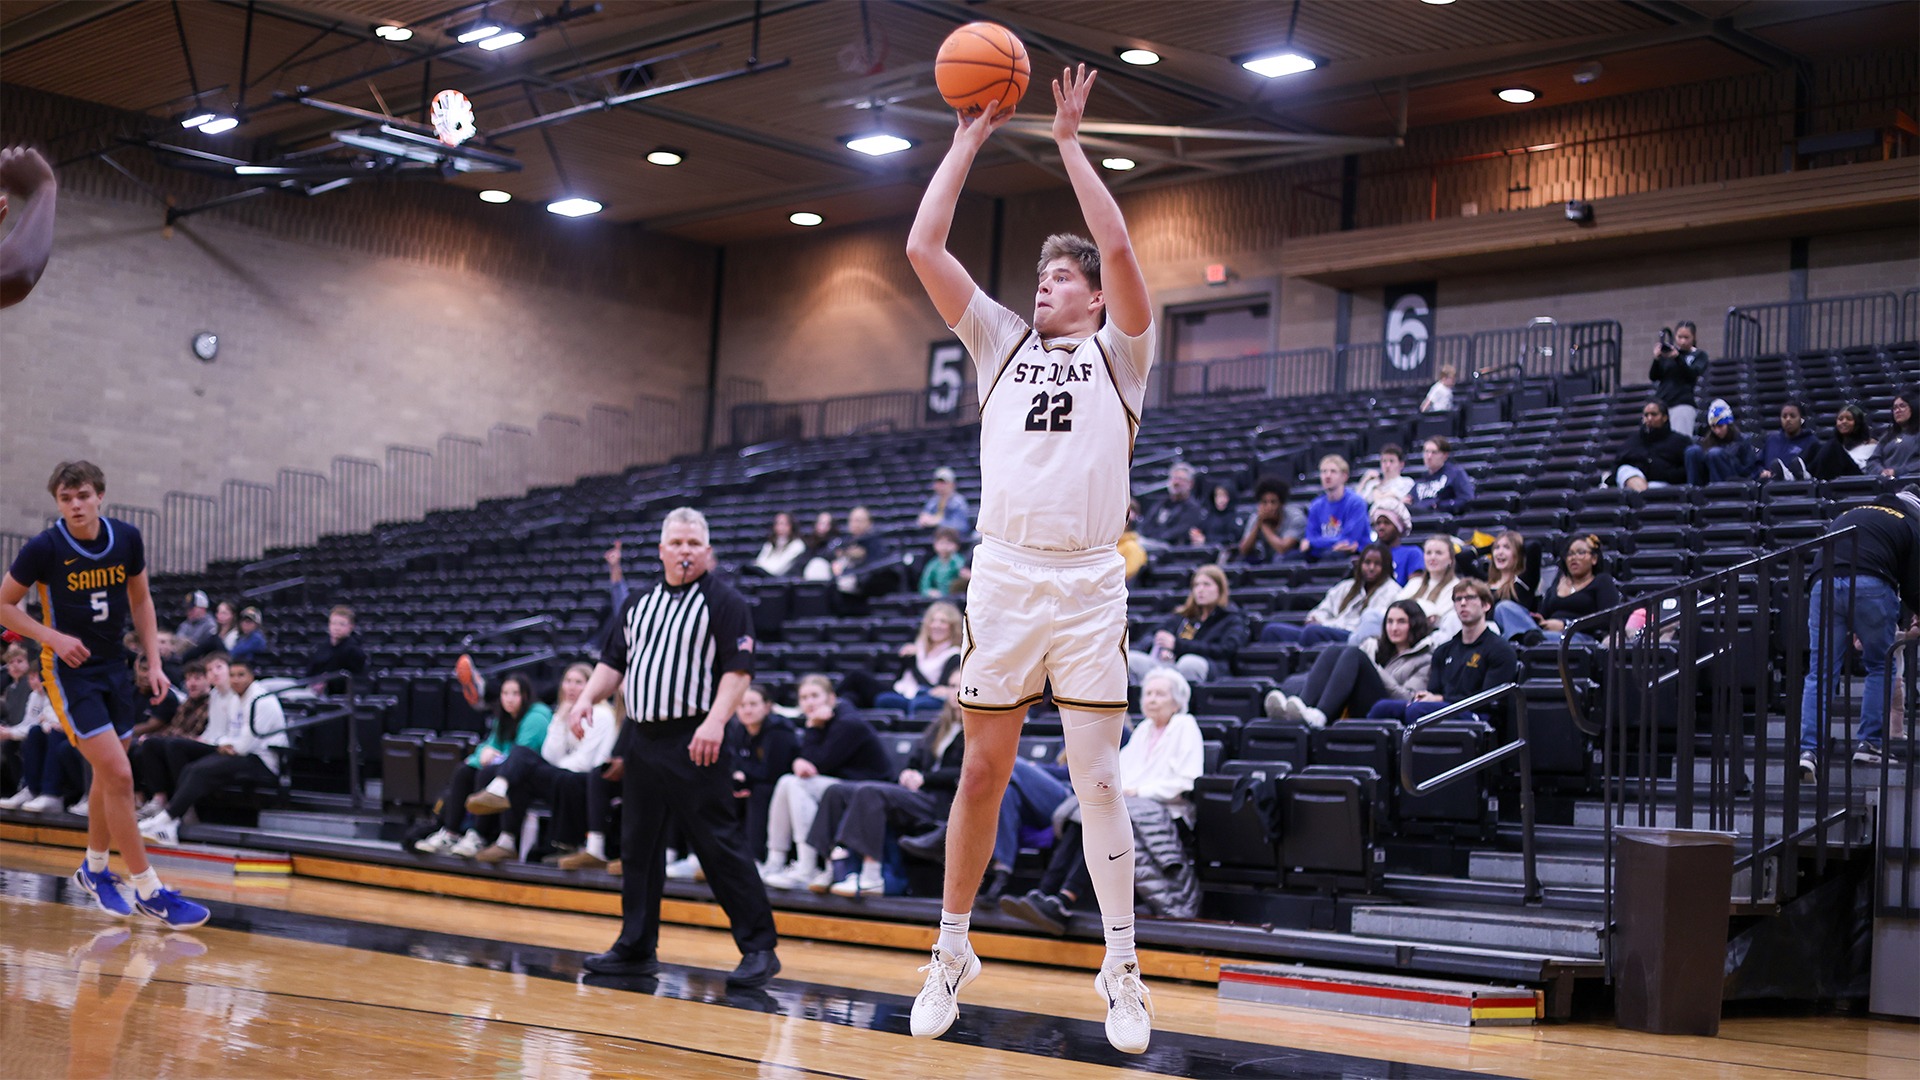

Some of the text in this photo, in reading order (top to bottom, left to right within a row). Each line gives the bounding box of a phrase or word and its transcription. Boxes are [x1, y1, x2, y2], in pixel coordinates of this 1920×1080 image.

[1386, 293, 1429, 371] 6
[928, 346, 962, 414] 5
[1014, 363, 1045, 384] ST.
[1024, 390, 1073, 432] 22
[66, 564, 126, 592] SAINTS
[90, 590, 109, 622] 5
